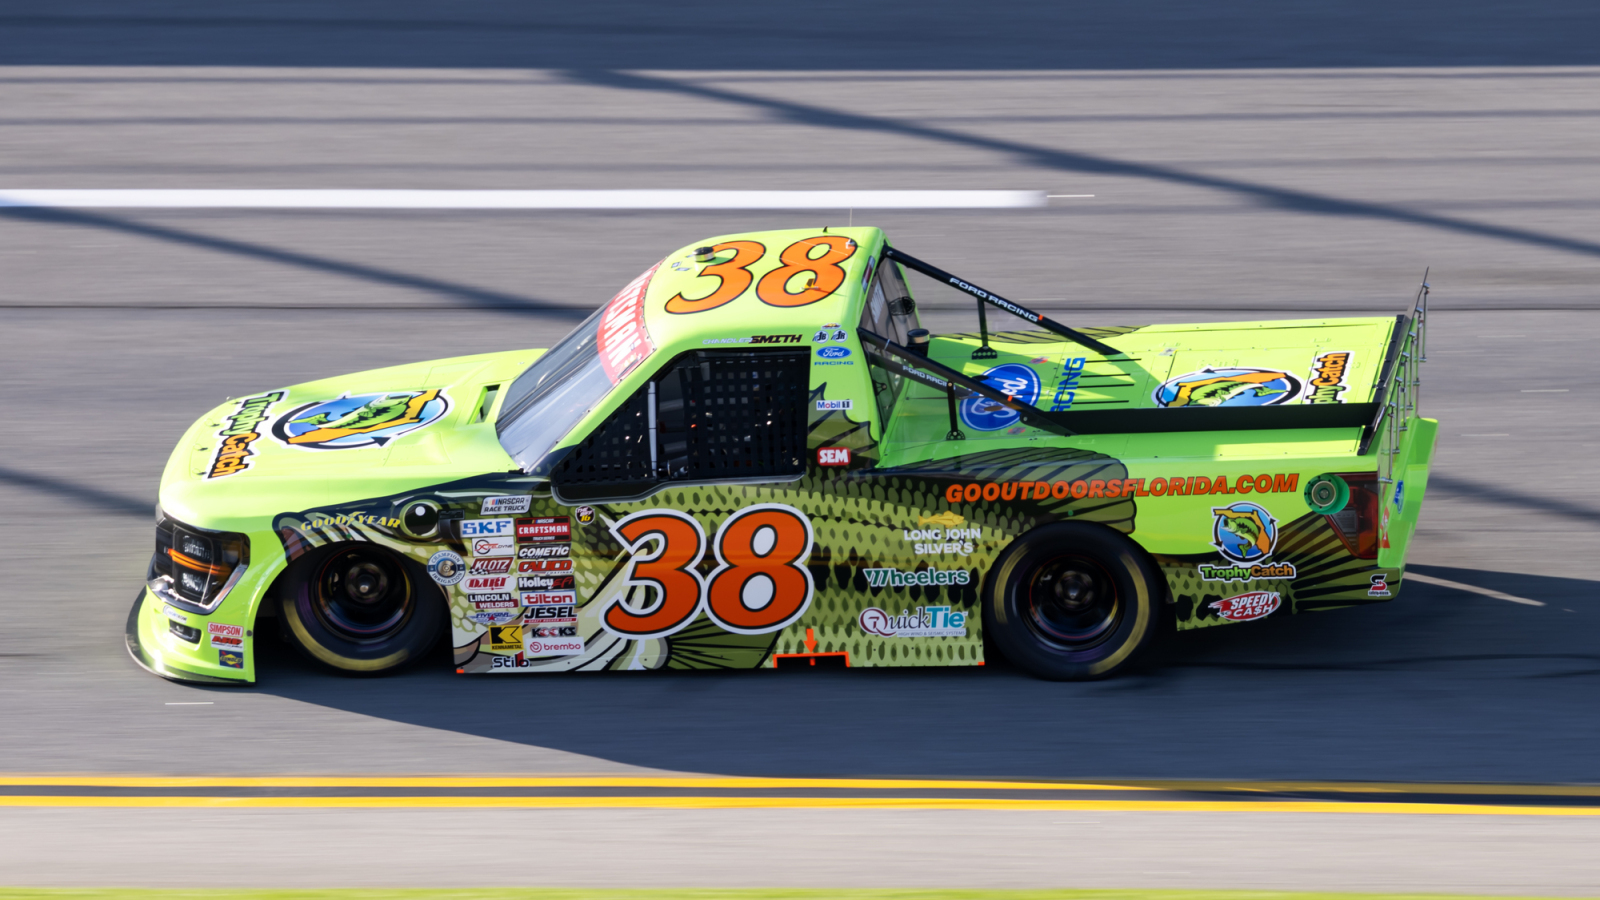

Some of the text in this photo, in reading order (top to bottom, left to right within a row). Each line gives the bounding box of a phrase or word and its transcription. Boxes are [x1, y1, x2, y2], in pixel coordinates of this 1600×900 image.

[664, 235, 858, 315] 38
[950, 277, 1038, 322] FORD RACING
[748, 334, 803, 344] SMITH
[823, 348, 845, 357] Ford
[902, 365, 926, 379] FORD
[1306, 352, 1351, 404] phyCatch
[817, 401, 841, 409] Mobil
[207, 391, 285, 479] TrophyCatch
[819, 449, 849, 463] SEM
[946, 473, 1299, 502] GOOUTDOORSFLORIDA.COM
[301, 511, 401, 531] GOODYEAR
[462, 520, 511, 535] SKF
[519, 525, 568, 534] CRAFTSMAN
[904, 529, 981, 541] LONG JOHN
[519, 546, 570, 557] COMETIC
[915, 540, 974, 556] SILVER'S
[474, 560, 508, 571] KLOTZ
[518, 561, 572, 572] CALICO
[600, 503, 814, 640] 38
[1200, 565, 1295, 580] TrophyCatch
[518, 577, 553, 589] Holley
[864, 568, 969, 586] Wheelers
[469, 594, 510, 602] LINCOLN
[524, 595, 573, 604] tilton
[1230, 594, 1275, 609] SPEEDY
[525, 607, 577, 618] JESEL
[860, 607, 964, 637] QuickTie
[209, 624, 241, 635] SIMPSON
[212, 636, 243, 645] ARP
[493, 651, 529, 668] Stilo
